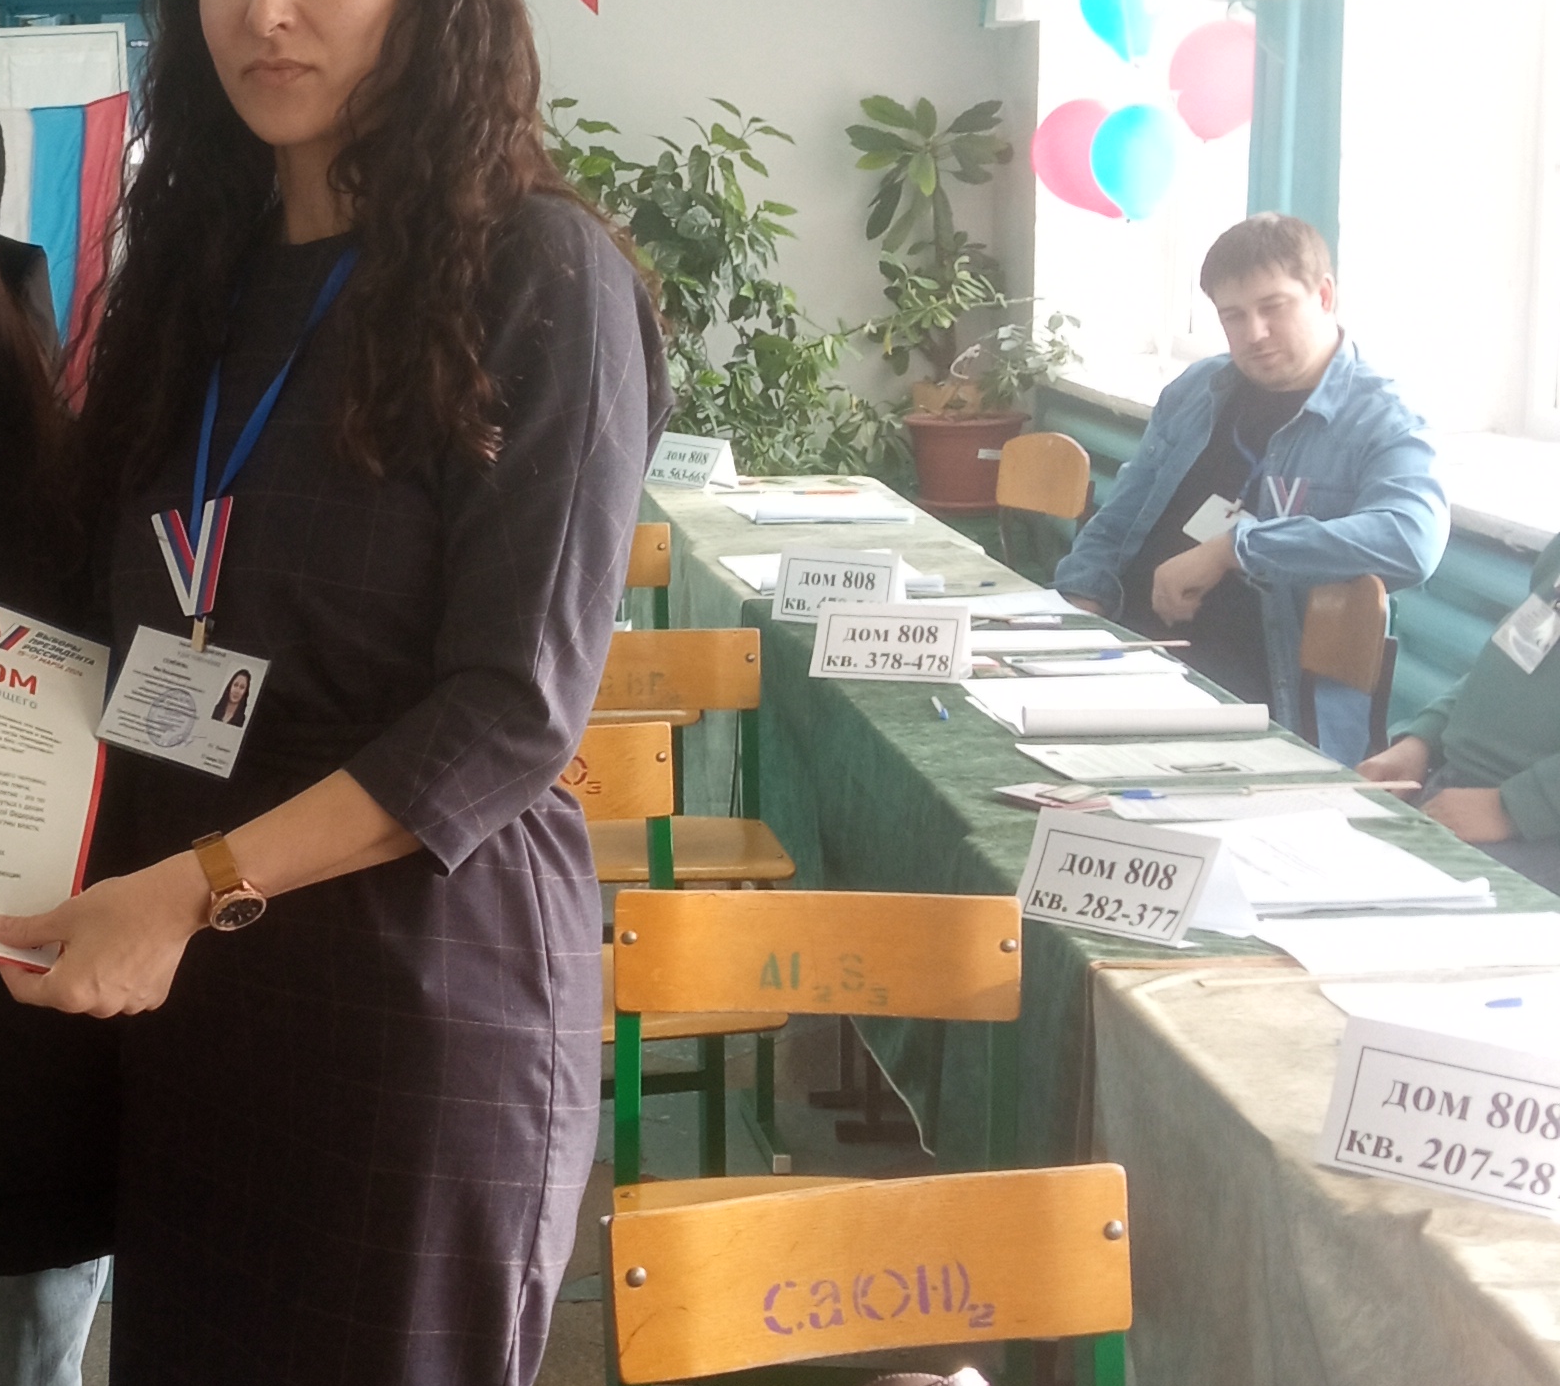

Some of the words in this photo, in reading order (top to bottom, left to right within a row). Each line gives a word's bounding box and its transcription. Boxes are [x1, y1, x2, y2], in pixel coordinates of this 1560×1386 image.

[664, 450, 686, 462] дом
[688, 451, 709, 465] 808
[798, 571, 836, 587] дом
[842, 570, 875, 590] 808
[784, 597, 812, 612] кв.
[842, 627, 889, 643] дом
[897, 625, 938, 644] 808
[826, 655, 858, 668] кв.
[865, 652, 950, 672] 378-478
[1057, 852, 1117, 881] дом
[1124, 857, 1178, 891] 808
[1030, 890, 1068, 913] кв.
[1075, 893, 1181, 932] 282-377
[1381, 1078, 1473, 1122] дом
[1485, 1091, 1560, 1141] 808
[1344, 1129, 1403, 1164] кв.
[1417, 1137, 1560, 1201] 207-28
